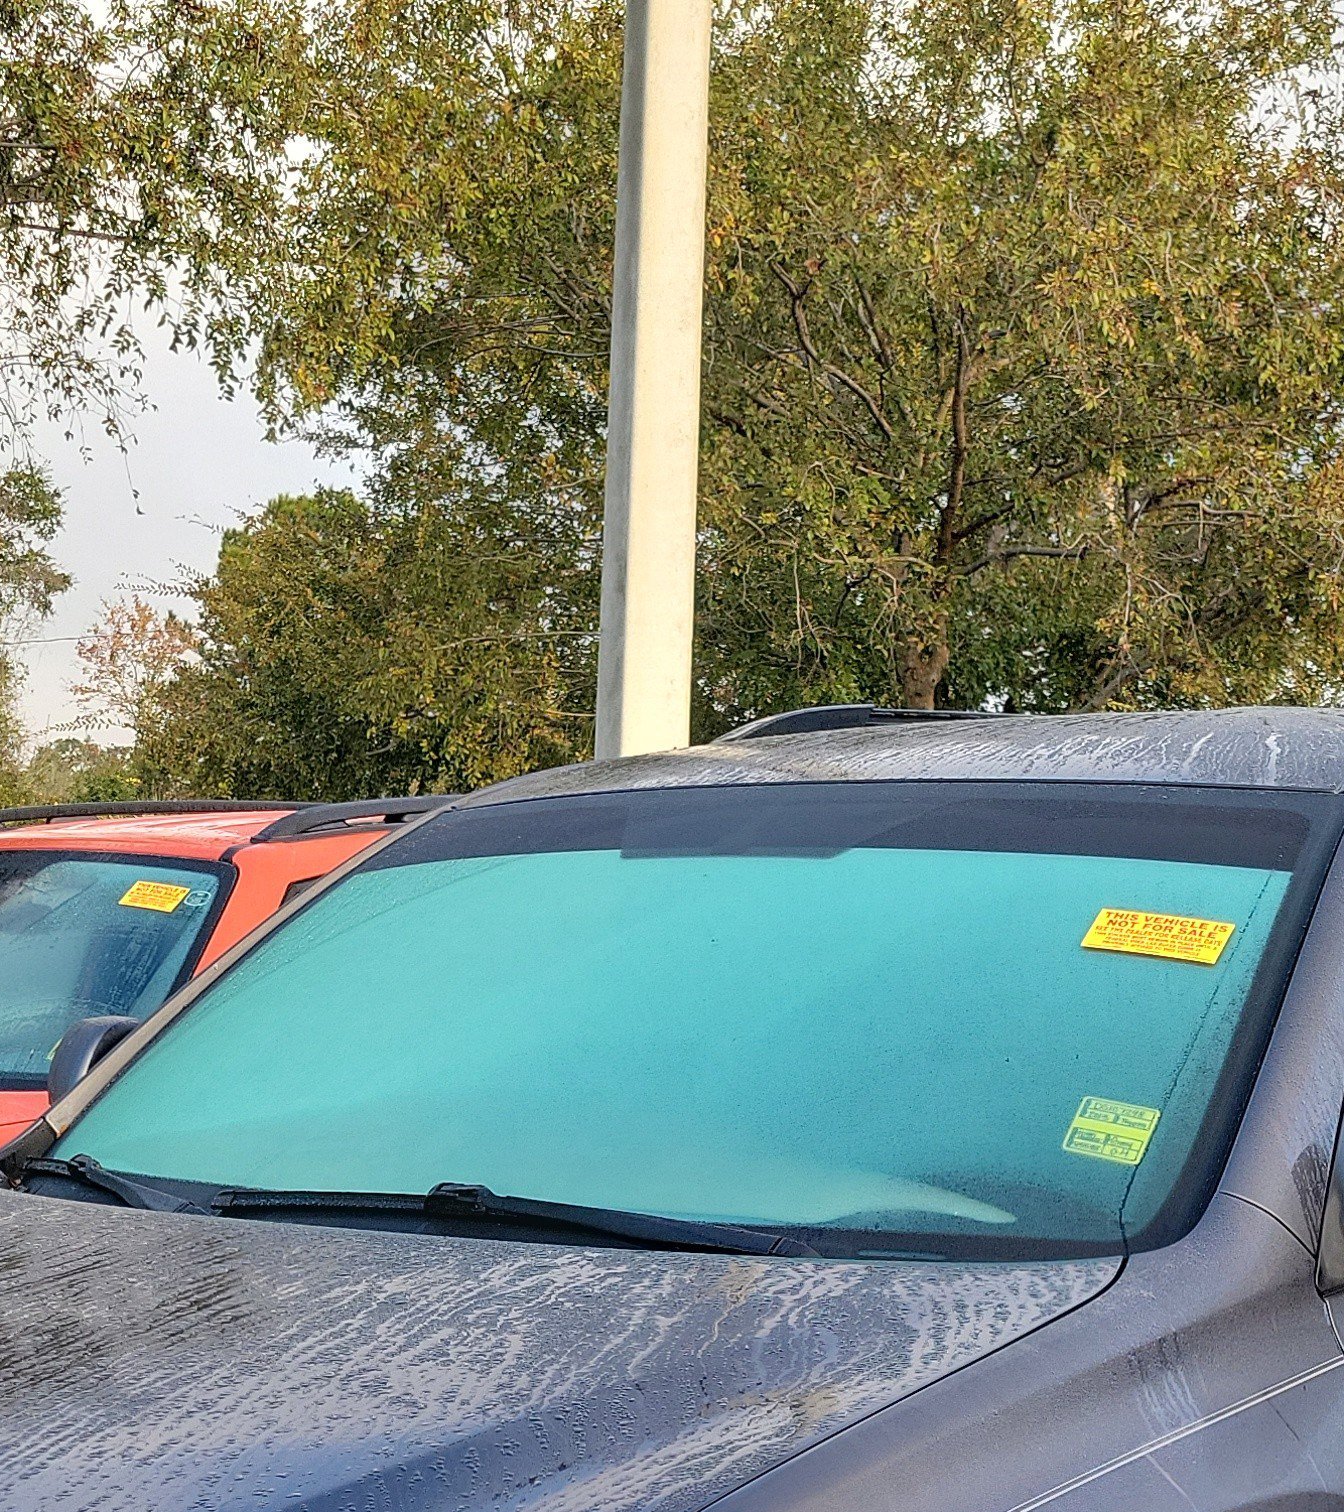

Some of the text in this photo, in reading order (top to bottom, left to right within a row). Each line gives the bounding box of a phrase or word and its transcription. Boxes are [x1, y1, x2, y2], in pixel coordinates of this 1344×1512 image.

[1105, 911, 1229, 933] THIS VEHICLE IS
[1106, 919, 1218, 940] NOT FOR SALE
